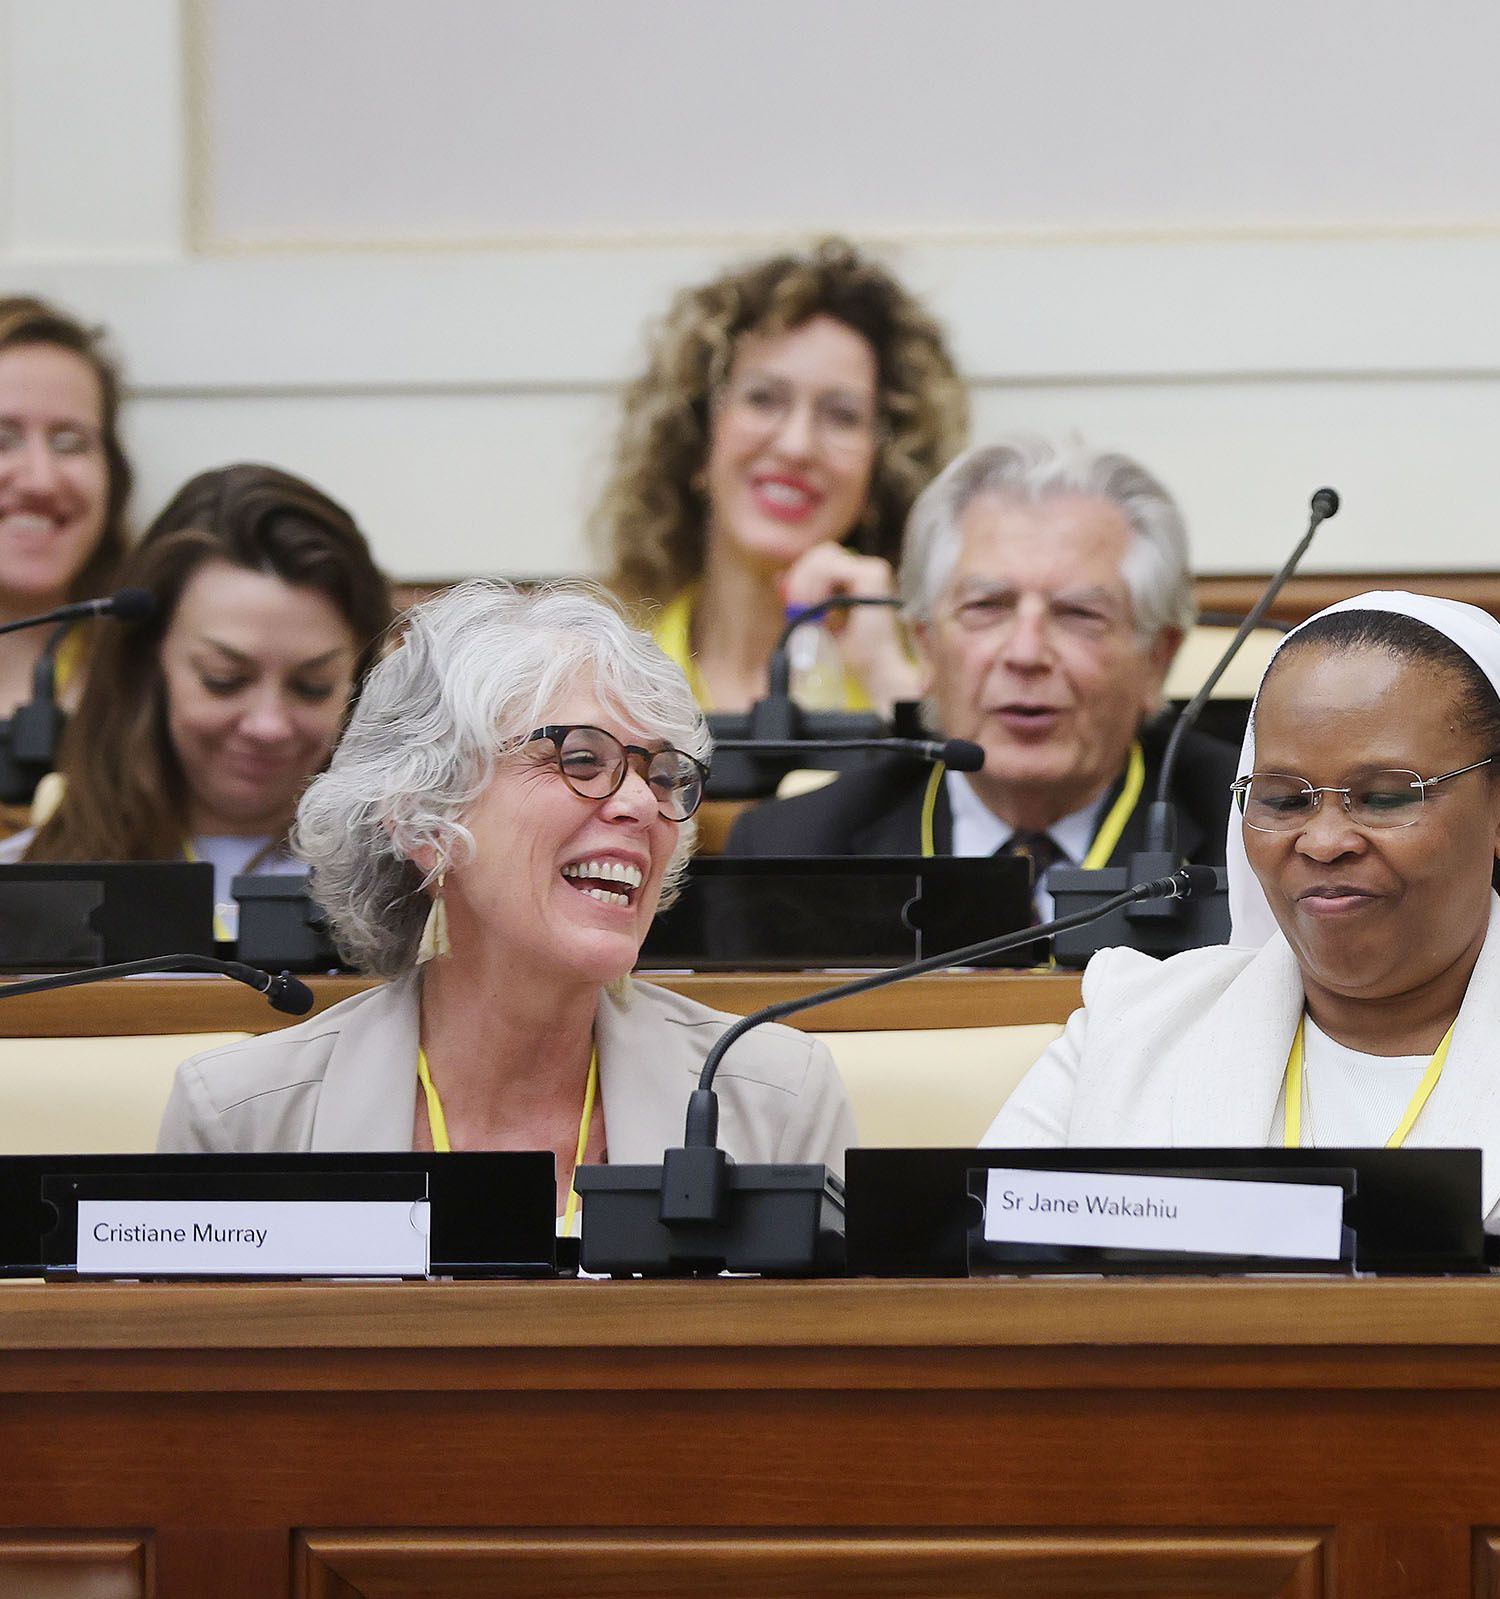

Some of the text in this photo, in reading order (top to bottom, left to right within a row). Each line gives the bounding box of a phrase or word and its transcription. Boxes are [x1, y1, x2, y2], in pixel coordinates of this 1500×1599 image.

[1002, 1190, 1178, 1219] Sr Jane Wakahiu
[93, 1222, 268, 1248] Cristiane Murray
